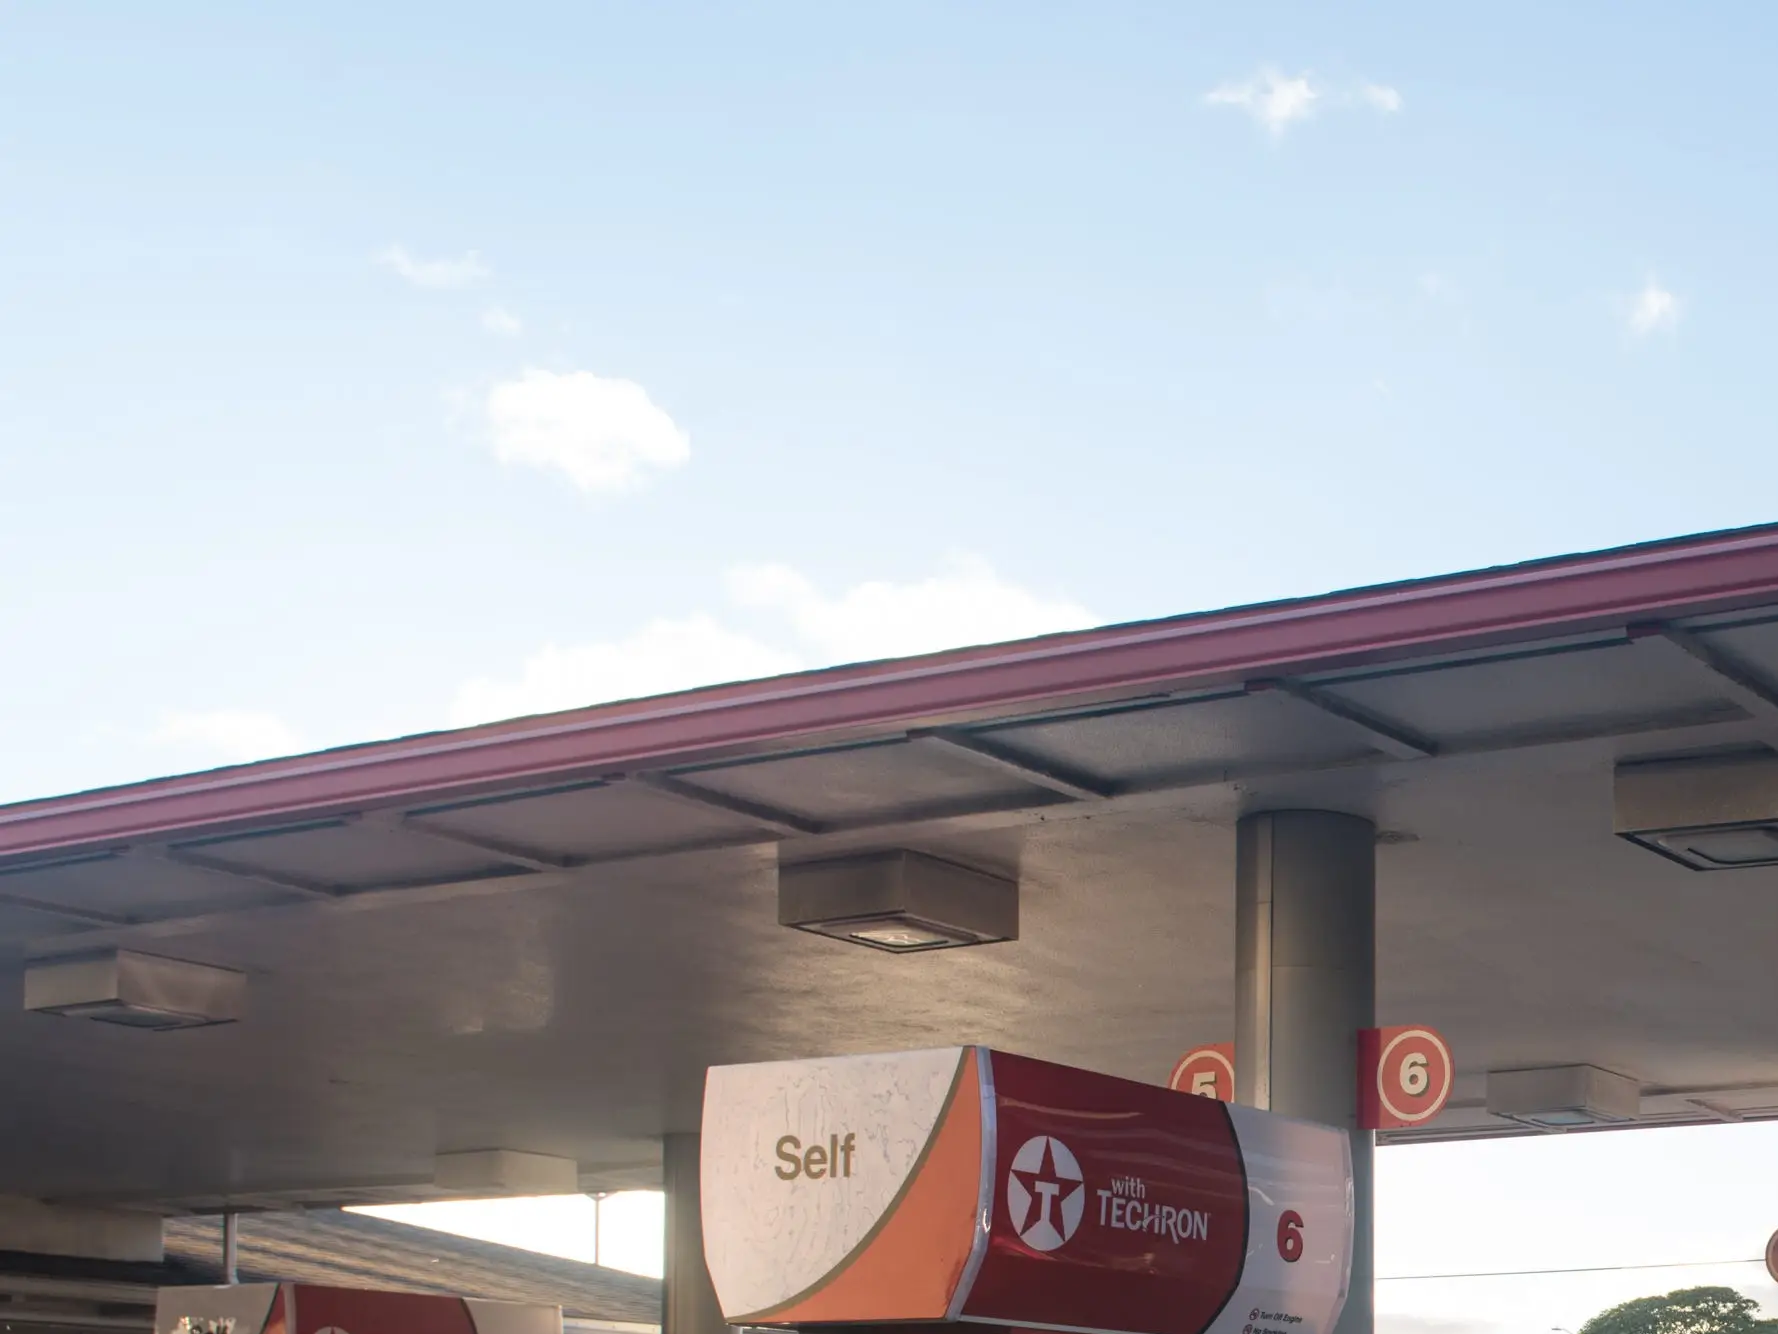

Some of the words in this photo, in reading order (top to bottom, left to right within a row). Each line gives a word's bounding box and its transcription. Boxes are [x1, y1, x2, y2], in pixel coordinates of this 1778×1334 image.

[1191, 1071, 1217, 1099] 5
[1400, 1052, 1429, 1096] 6
[774, 1132, 857, 1181] Self
[1111, 1175, 1146, 1199] with
[1096, 1190, 1209, 1245] TECHRON
[1276, 1209, 1305, 1263] 6
